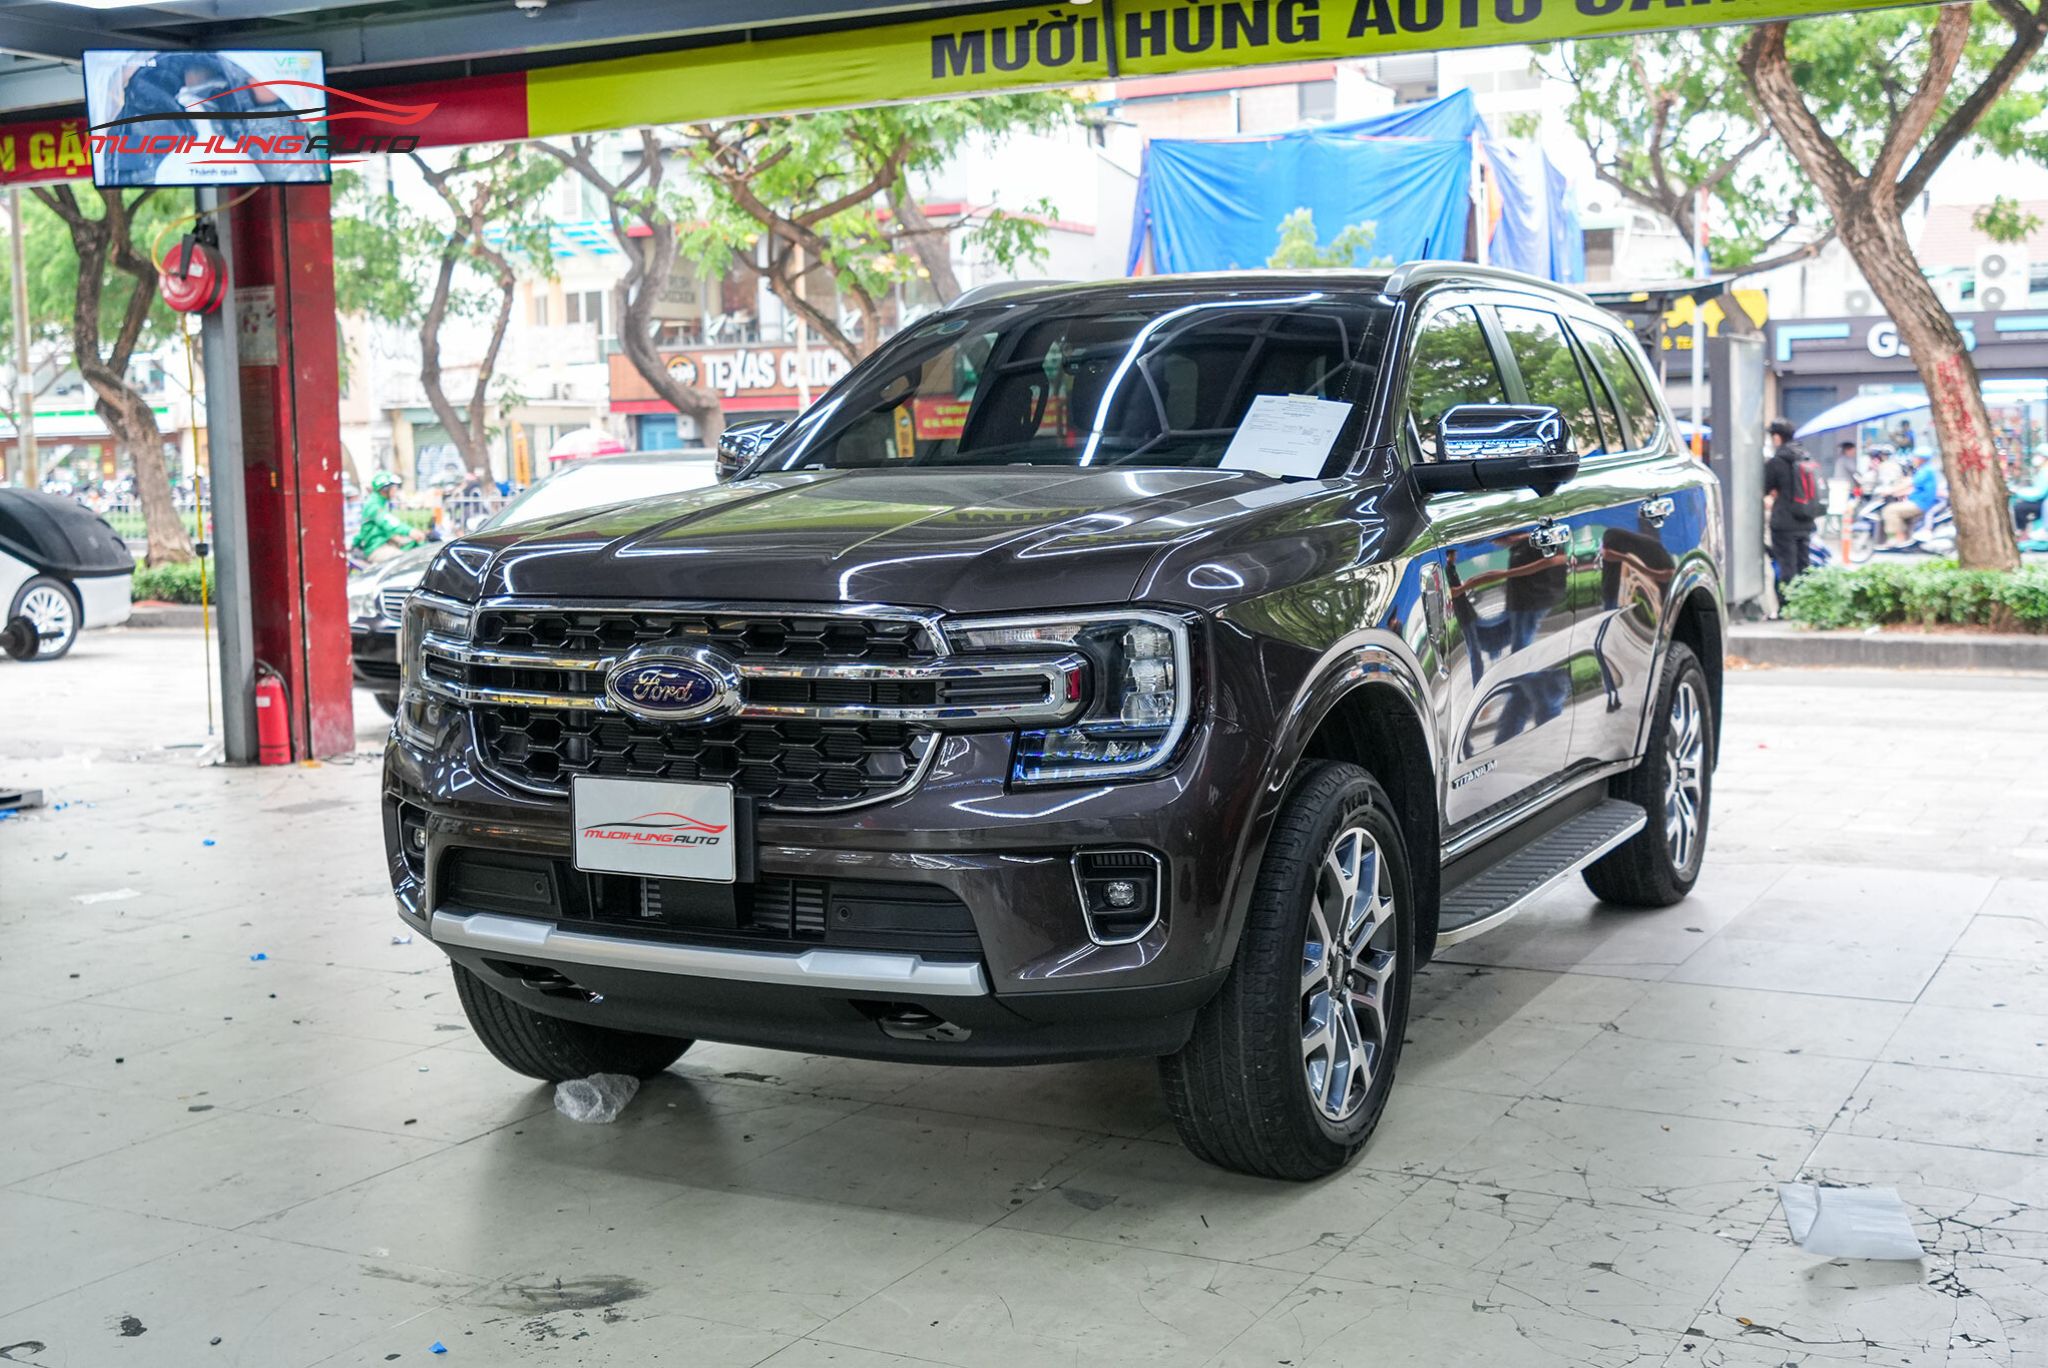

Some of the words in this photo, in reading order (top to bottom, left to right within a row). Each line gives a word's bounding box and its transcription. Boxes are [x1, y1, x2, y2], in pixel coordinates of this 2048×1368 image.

[931, 10, 1099, 79] MƯỜI
[1126, 0, 1320, 59] HÙNG
[701, 349, 777, 397] TEXAS
[633, 669, 694, 702] Ford
